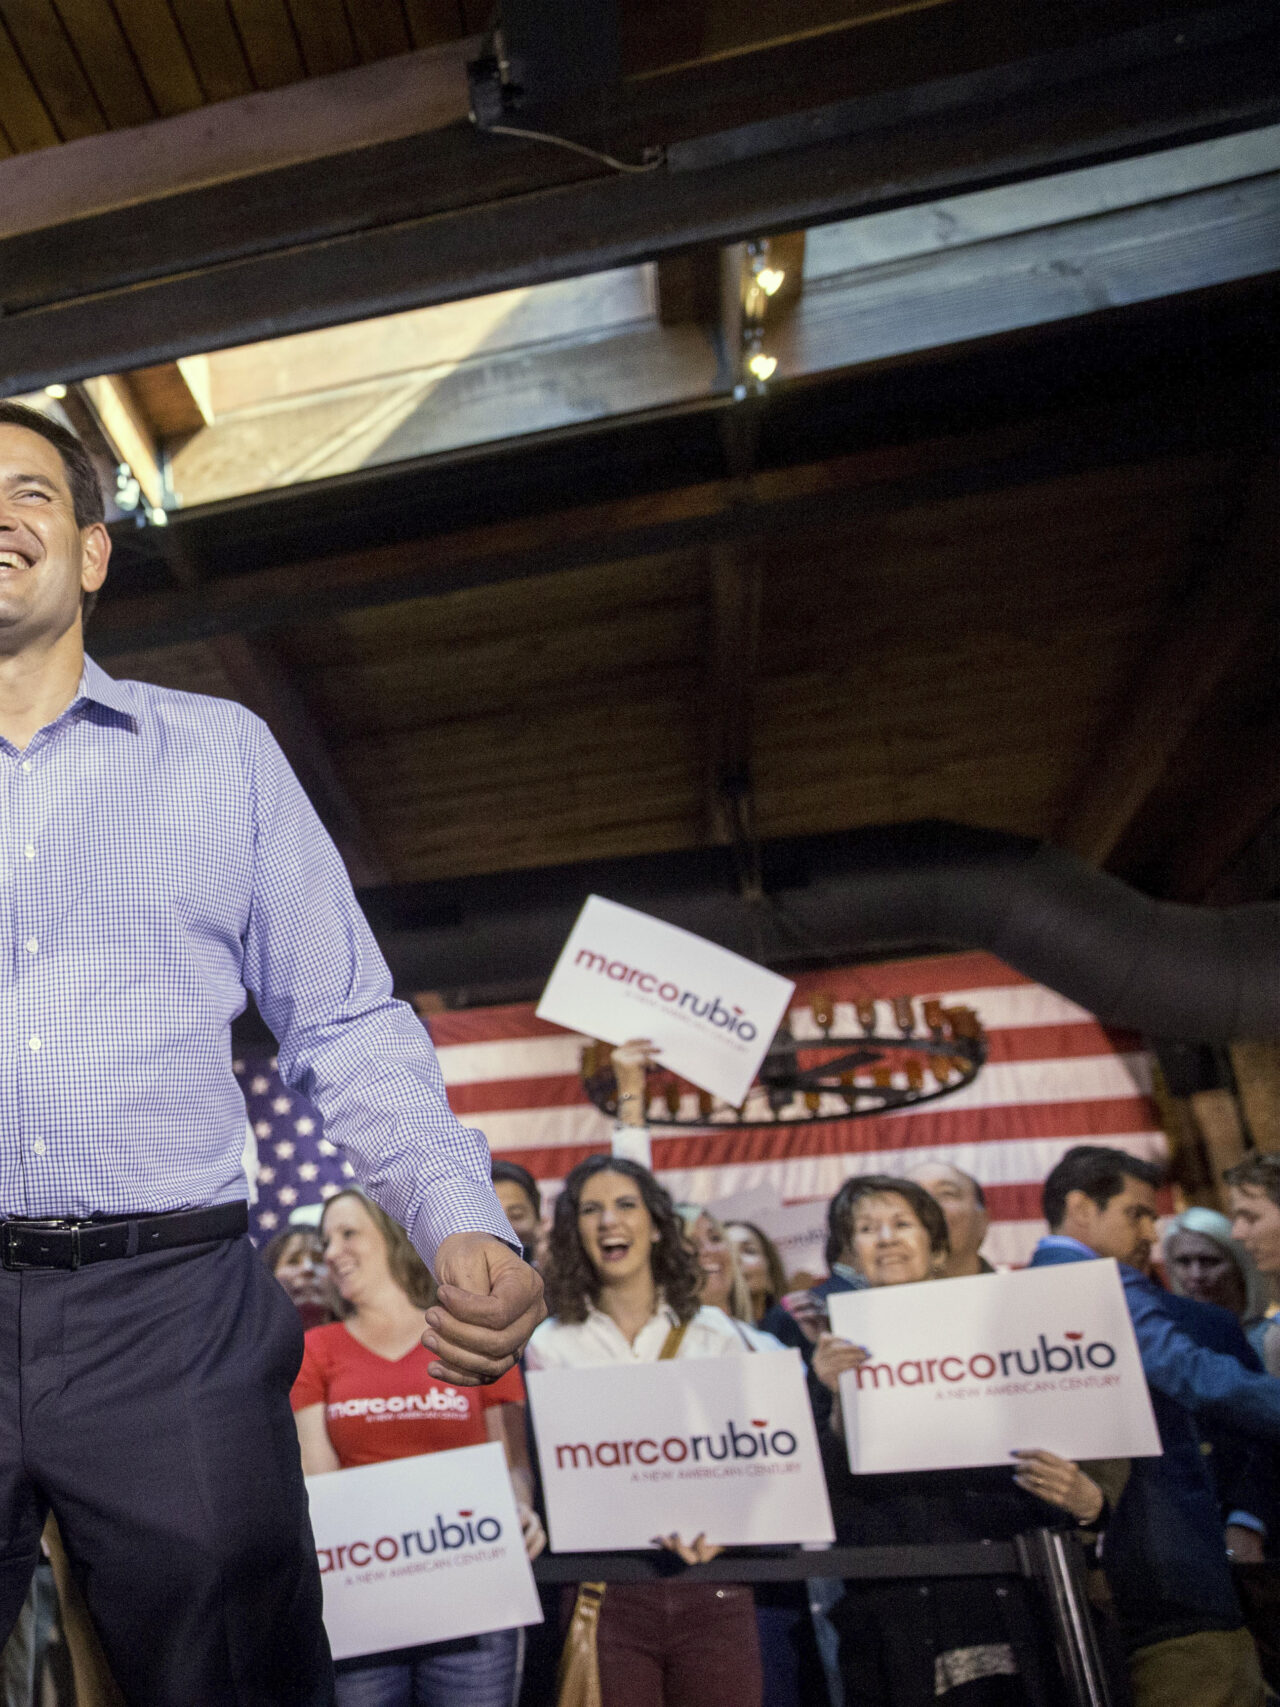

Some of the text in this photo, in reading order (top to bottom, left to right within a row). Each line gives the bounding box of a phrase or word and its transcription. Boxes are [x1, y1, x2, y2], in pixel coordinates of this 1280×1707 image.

[985, 1381, 1056, 1396] AMERICAN
[1059, 1375, 1120, 1391] CENTURY
[555, 1419, 797, 1470] marcorubio
[316, 1510, 502, 1573] arcorubio
